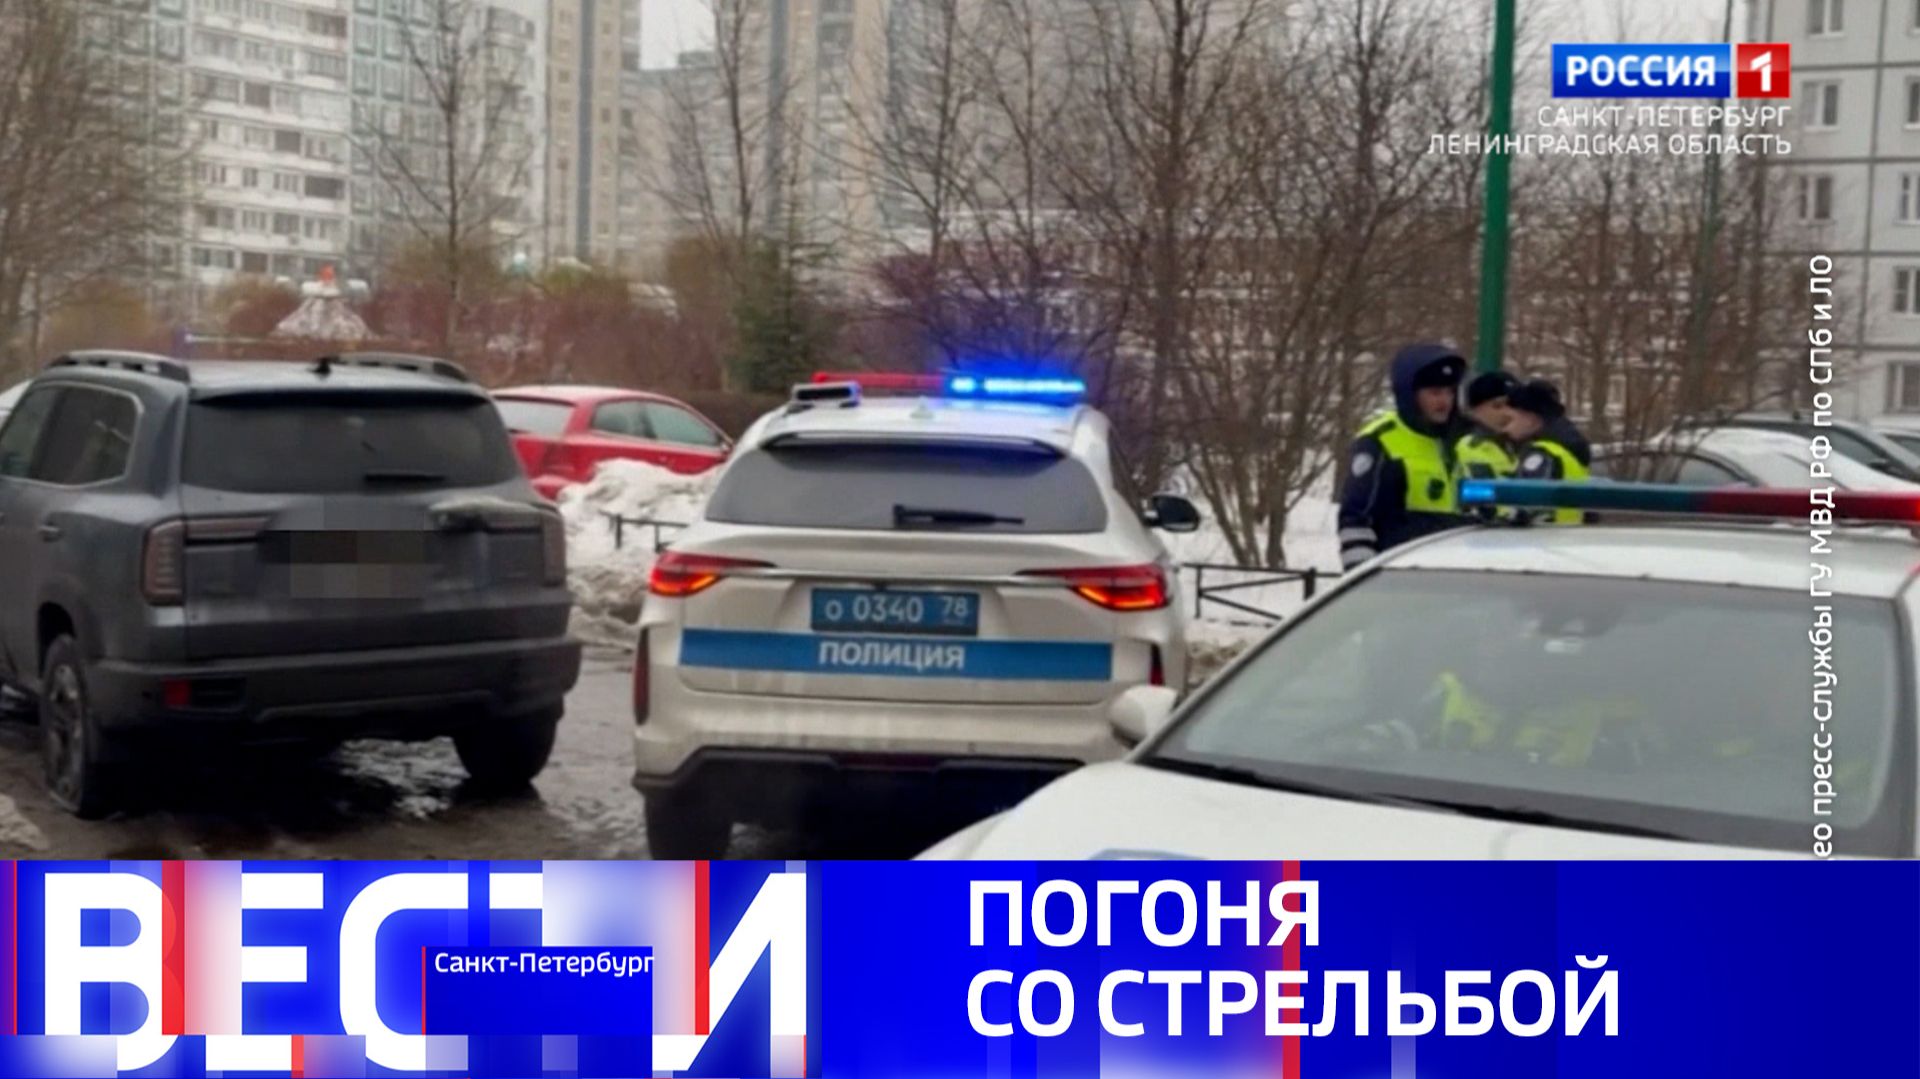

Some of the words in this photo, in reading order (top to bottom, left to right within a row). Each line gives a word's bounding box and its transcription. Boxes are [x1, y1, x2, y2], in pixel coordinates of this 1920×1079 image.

[852, 594, 924, 623] 0340
[940, 595, 970, 618] 78
[818, 640, 966, 673] ПОЛИЦИЯ
